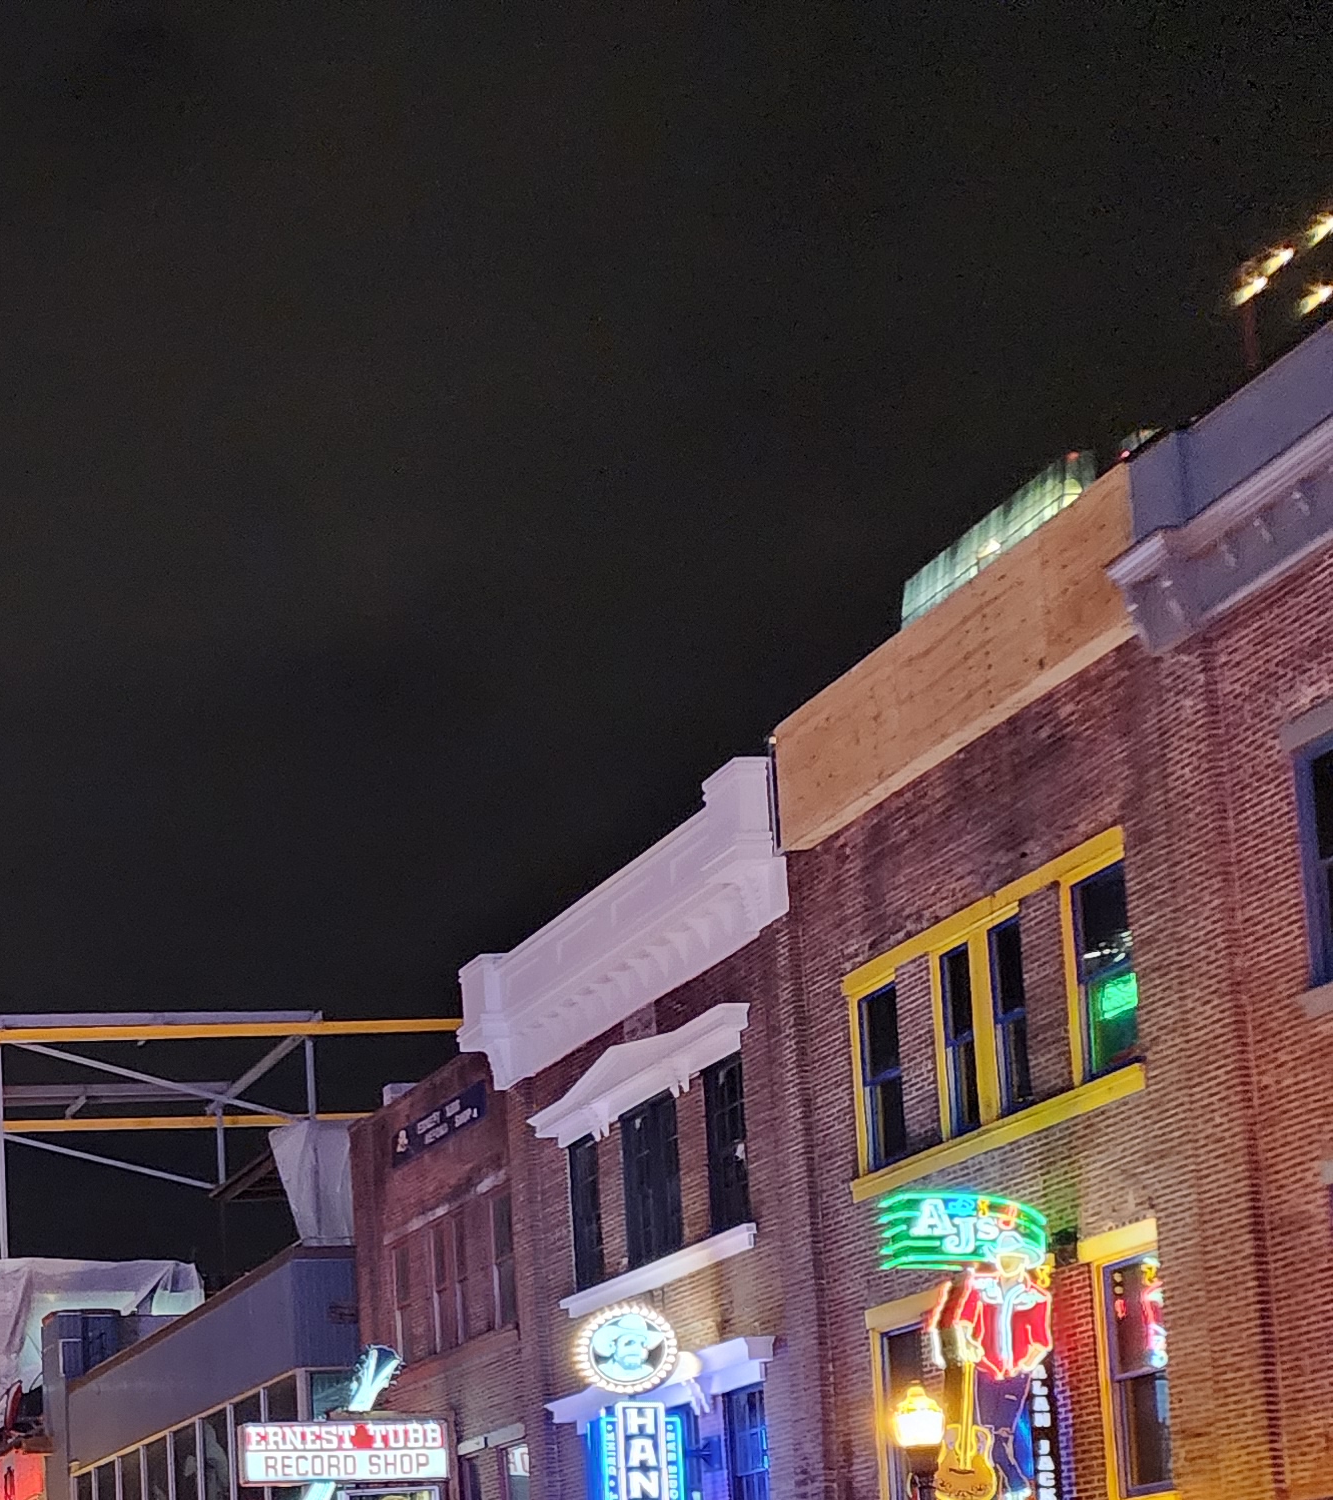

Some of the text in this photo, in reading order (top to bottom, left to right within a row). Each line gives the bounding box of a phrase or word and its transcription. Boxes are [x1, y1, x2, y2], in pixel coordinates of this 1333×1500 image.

[1032, 1364, 1052, 1428] ALAN
[246, 1421, 443, 1451] ERNEST TUBB
[264, 1452, 430, 1478] RECORD SHOP
